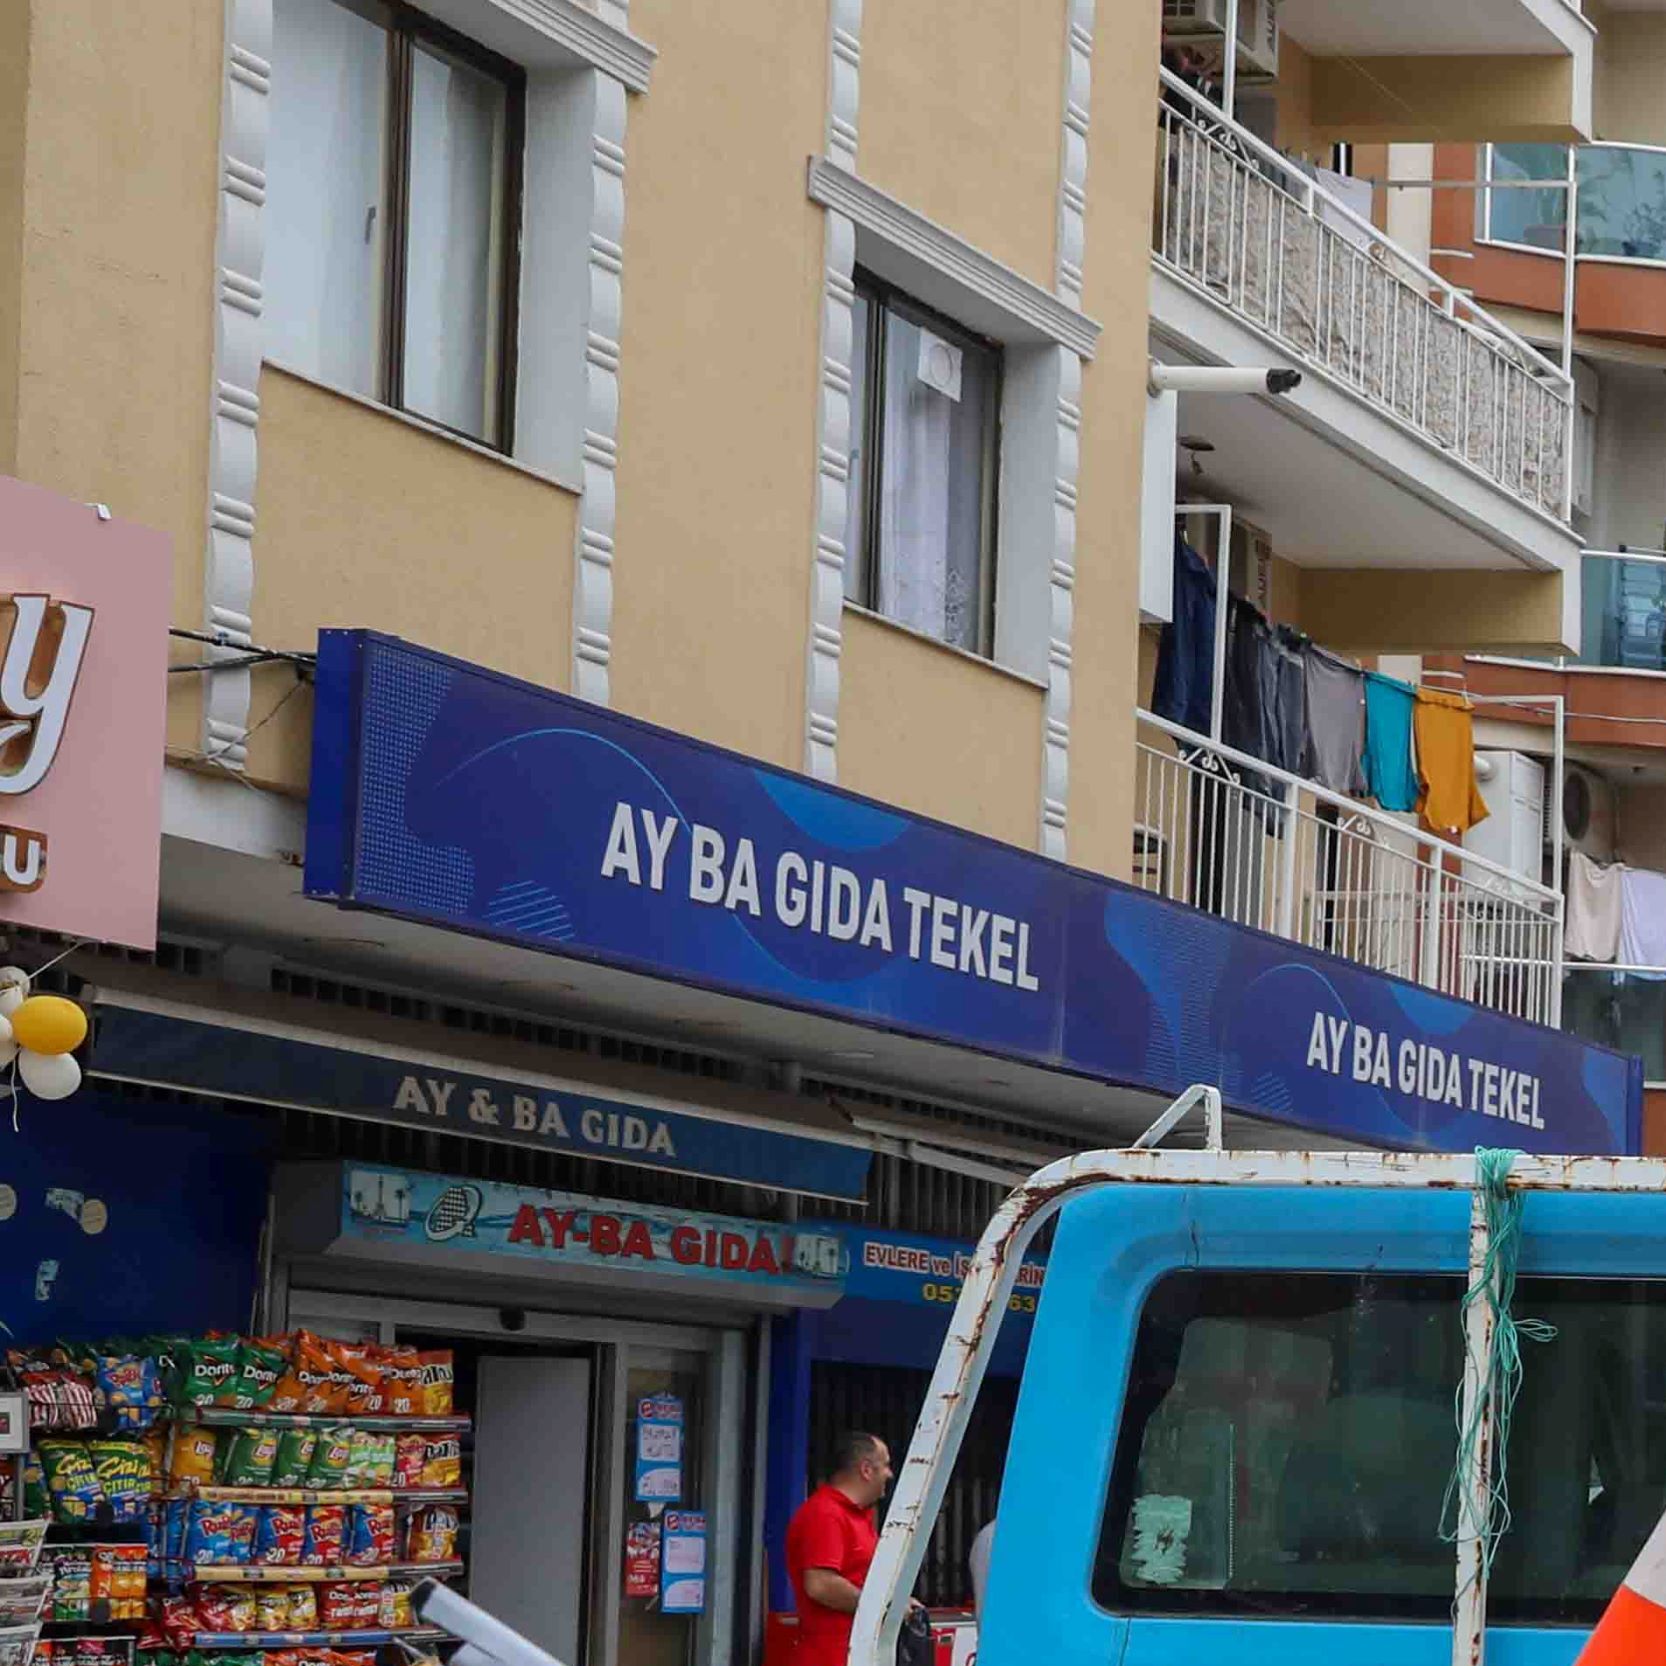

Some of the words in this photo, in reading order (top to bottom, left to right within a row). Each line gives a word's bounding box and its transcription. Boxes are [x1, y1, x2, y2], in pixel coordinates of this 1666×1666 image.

[601, 801, 678, 891] AY
[688, 823, 760, 916] BA
[776, 850, 893, 953] GIDA
[904, 886, 1039, 992] TEKEL
[1307, 1010, 1348, 1074] AY
[1353, 1025, 1391, 1089] BA
[1399, 1039, 1462, 1108] GIDA
[1468, 1059, 1545, 1130] TEKEL
[394, 1075, 456, 1118] AY
[469, 1086, 499, 1126] &
[513, 1095, 567, 1140] BA
[581, 1108, 678, 1158] GIDA
[507, 1203, 654, 1261] AY-BA
[864, 1241, 930, 1274] EVLERE
[931, 1256, 951, 1277] ve
